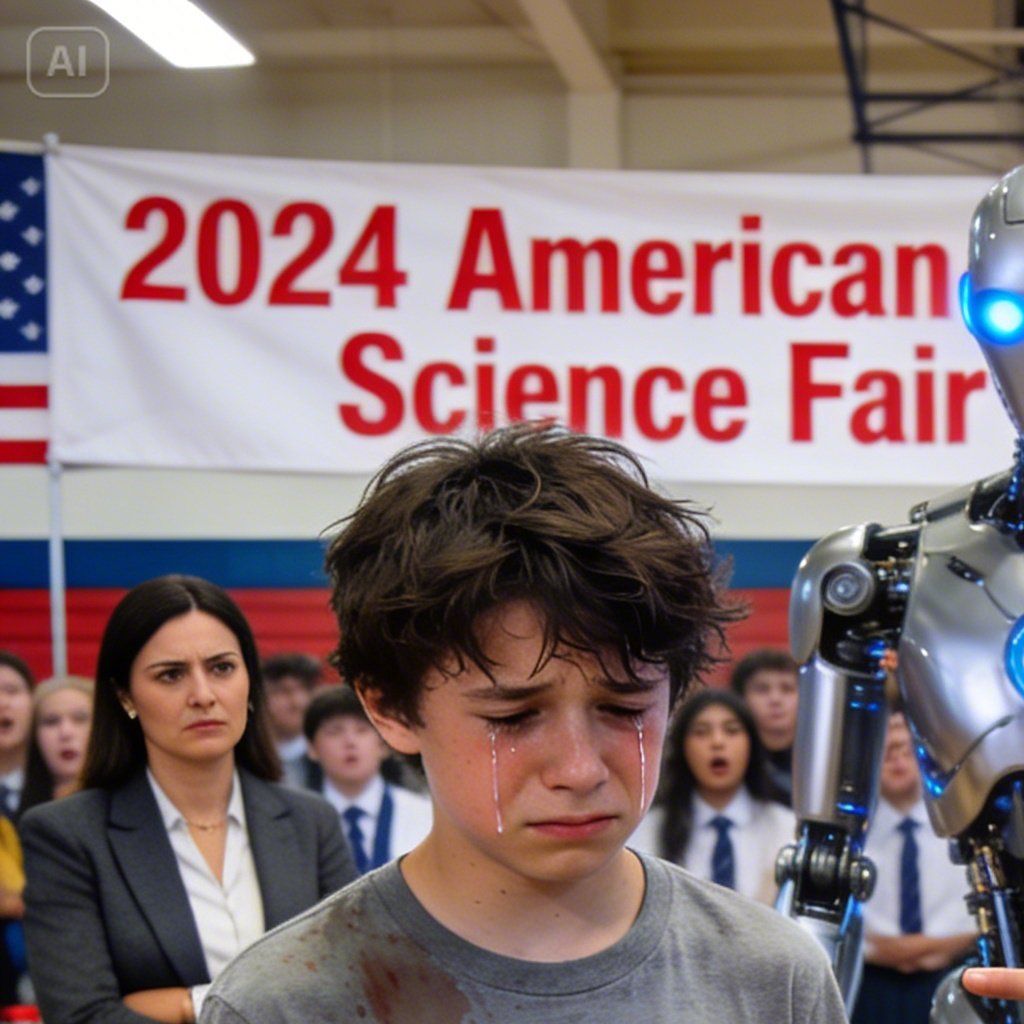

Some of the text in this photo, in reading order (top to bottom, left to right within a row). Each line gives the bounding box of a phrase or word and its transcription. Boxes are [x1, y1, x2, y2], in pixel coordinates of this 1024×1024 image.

[120, 195, 408, 309] 2024
[446, 207, 950, 318] American
[338, 331, 988, 445] Science Fair
